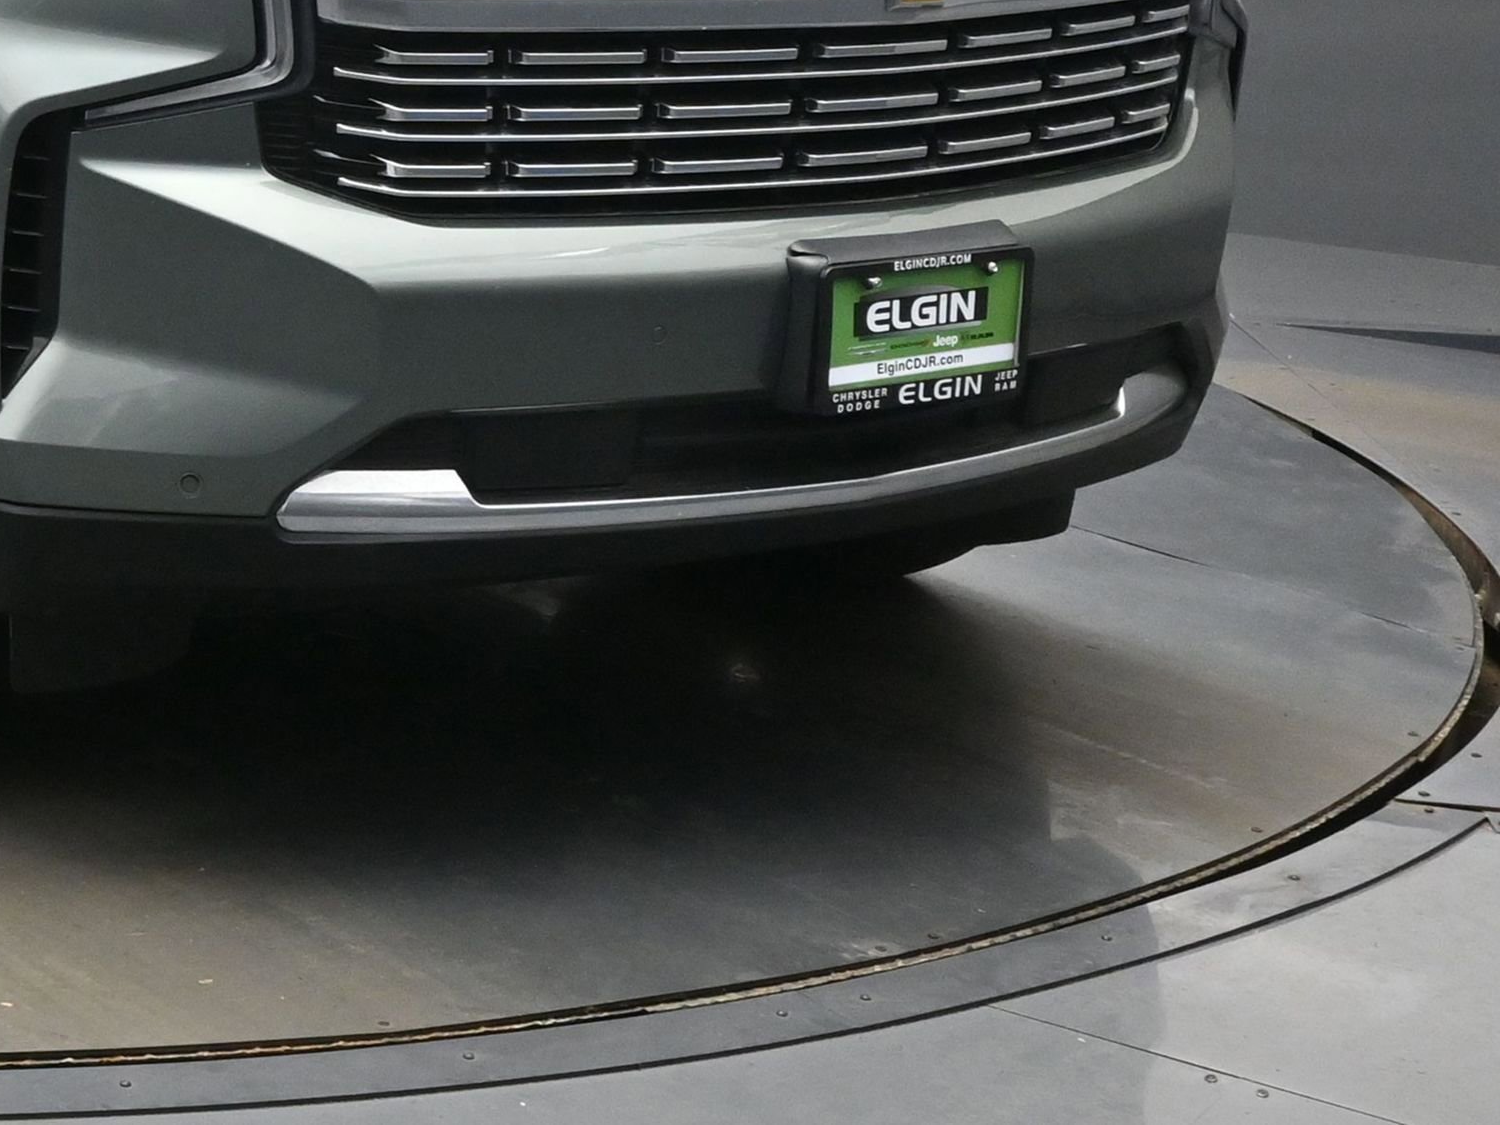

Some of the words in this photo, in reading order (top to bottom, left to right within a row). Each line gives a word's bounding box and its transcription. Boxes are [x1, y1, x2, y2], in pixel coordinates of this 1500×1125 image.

[893, 254, 972, 272] ELGINCDJR.COM
[866, 290, 976, 333] ELGIN
[932, 335, 959, 347] Jeep
[877, 354, 964, 376] ElginCDJR.com
[994, 369, 1018, 381] JEEP
[898, 374, 982, 405] ELGIN
[994, 380, 1018, 392] RAM
[832, 387, 889, 404] CHRYSLER
[837, 399, 881, 414] DODGE
